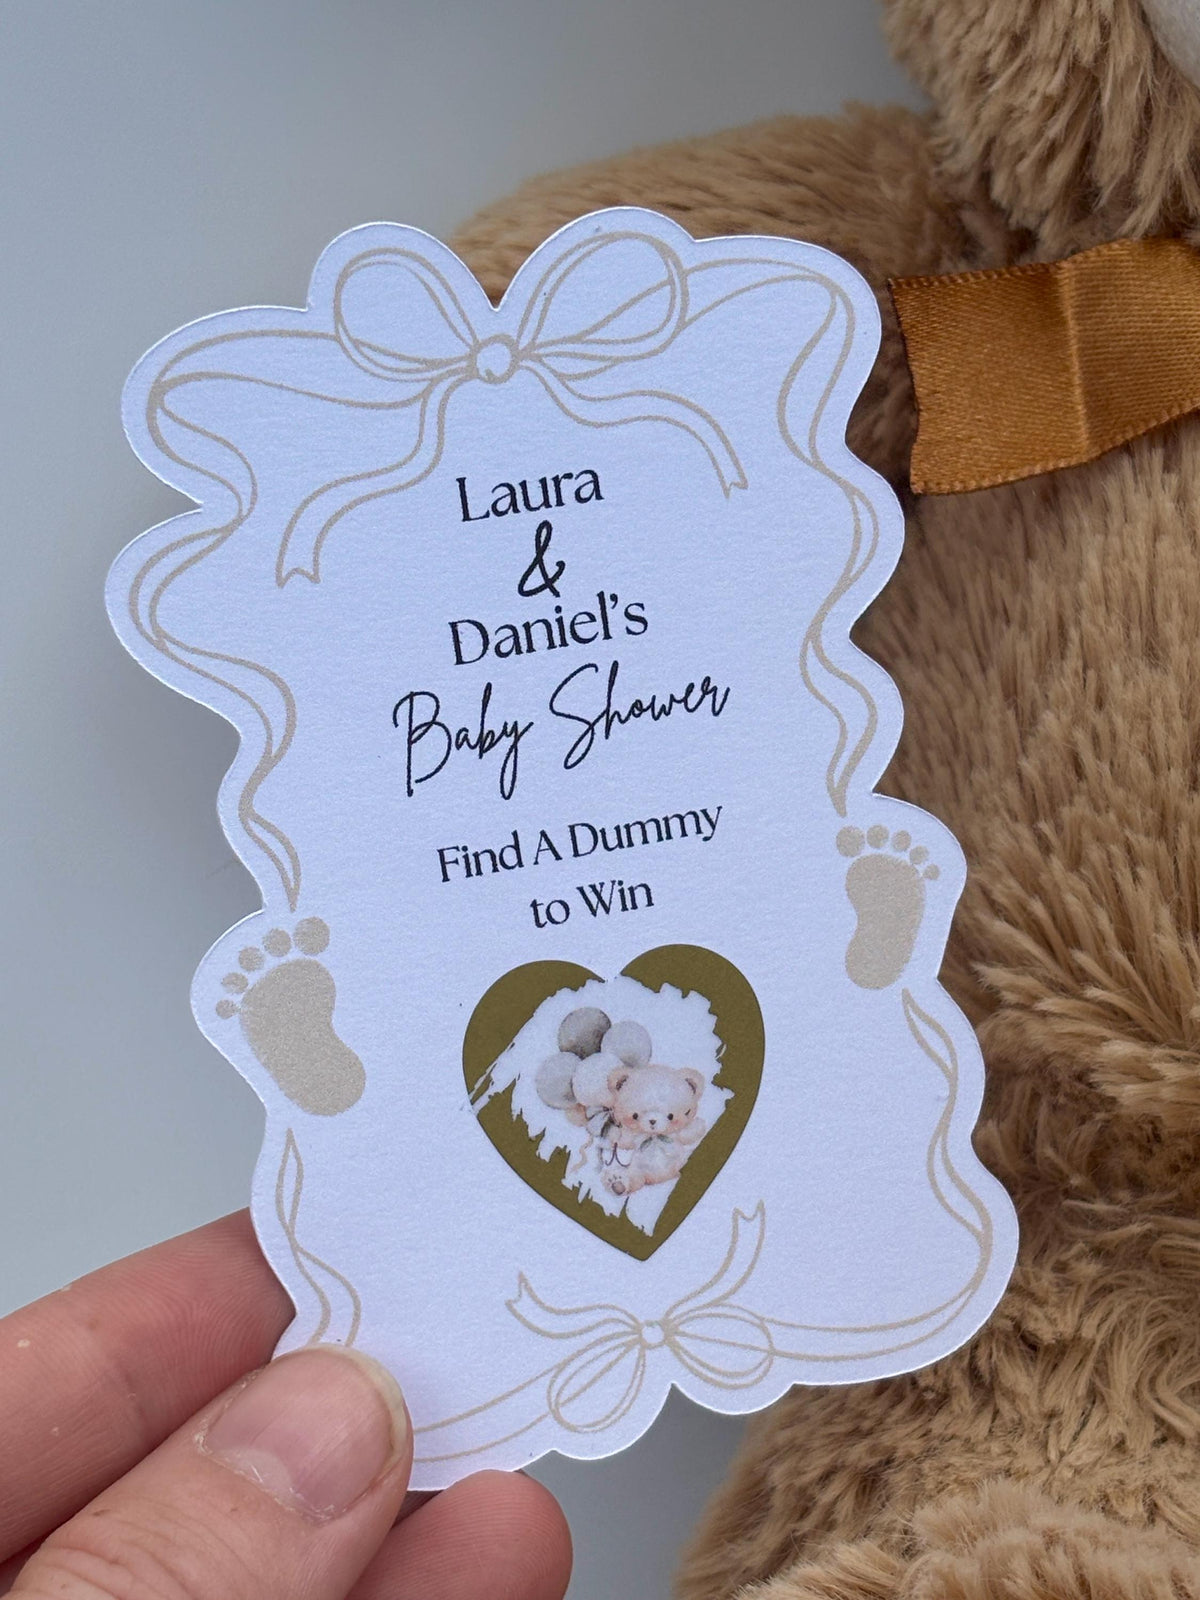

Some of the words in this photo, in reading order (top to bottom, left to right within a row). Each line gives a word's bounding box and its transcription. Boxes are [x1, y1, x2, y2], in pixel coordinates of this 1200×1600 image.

[456, 469, 604, 522] Laura
[517, 519, 566, 598] &
[448, 591, 649, 665] Daniel's
[393, 682, 534, 800] Baby
[549, 660, 731, 770] Shower
[437, 830, 524, 882] Find
[533, 830, 562, 866] A
[568, 806, 722, 857] Dummy
[530, 898, 570, 928] to
[576, 879, 655, 917] Win
